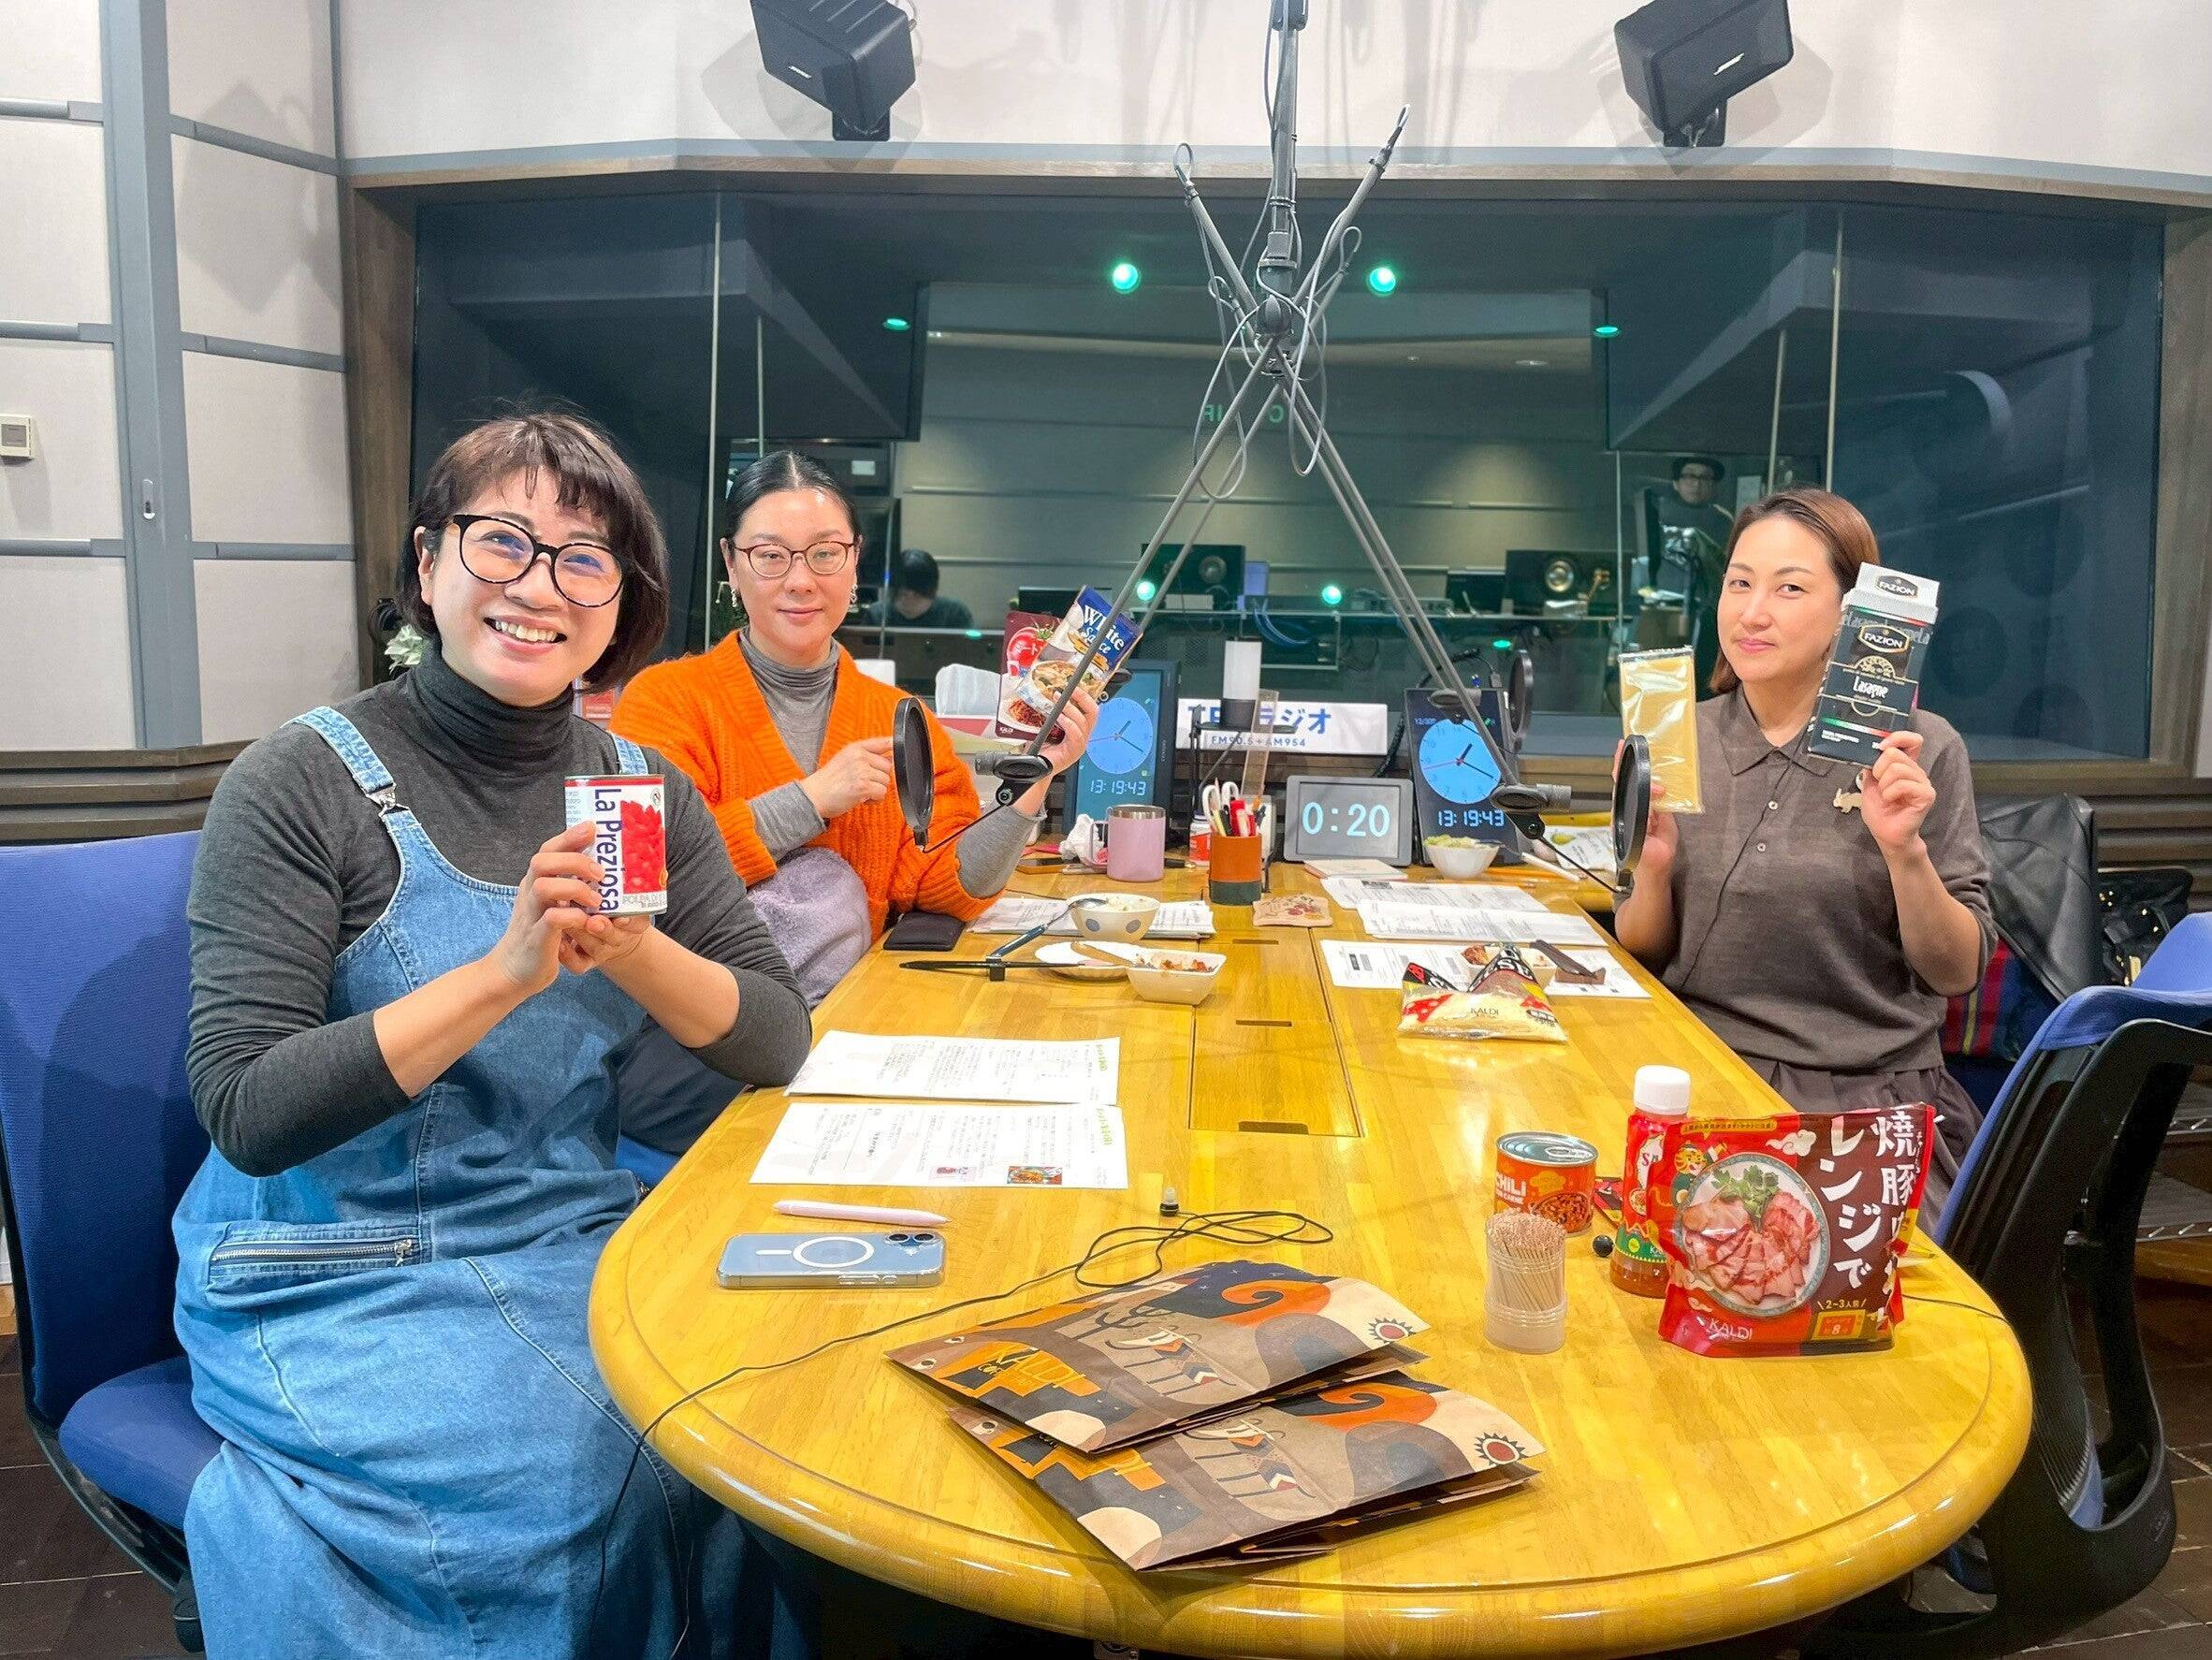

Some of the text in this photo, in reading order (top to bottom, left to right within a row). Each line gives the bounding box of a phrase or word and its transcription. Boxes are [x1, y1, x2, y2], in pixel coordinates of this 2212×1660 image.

[1879, 581, 1915, 596] FAZION
[1085, 628, 1112, 654] Sace
[1864, 633, 1904, 648] FAZION
[1853, 676, 1889, 699] Lasagne
[1187, 705, 1332, 735] TBラジオ
[1090, 779, 1147, 796] 13:19:43
[1302, 801, 1390, 837] 0:20
[1437, 809, 1505, 827] 13:19:43
[594, 788, 626, 911] La Preziosa
[1471, 1007, 1499, 1016] KALDI
[1820, 1115, 1882, 1289] レンジで
[1708, 1318, 1753, 1341] KALDI
